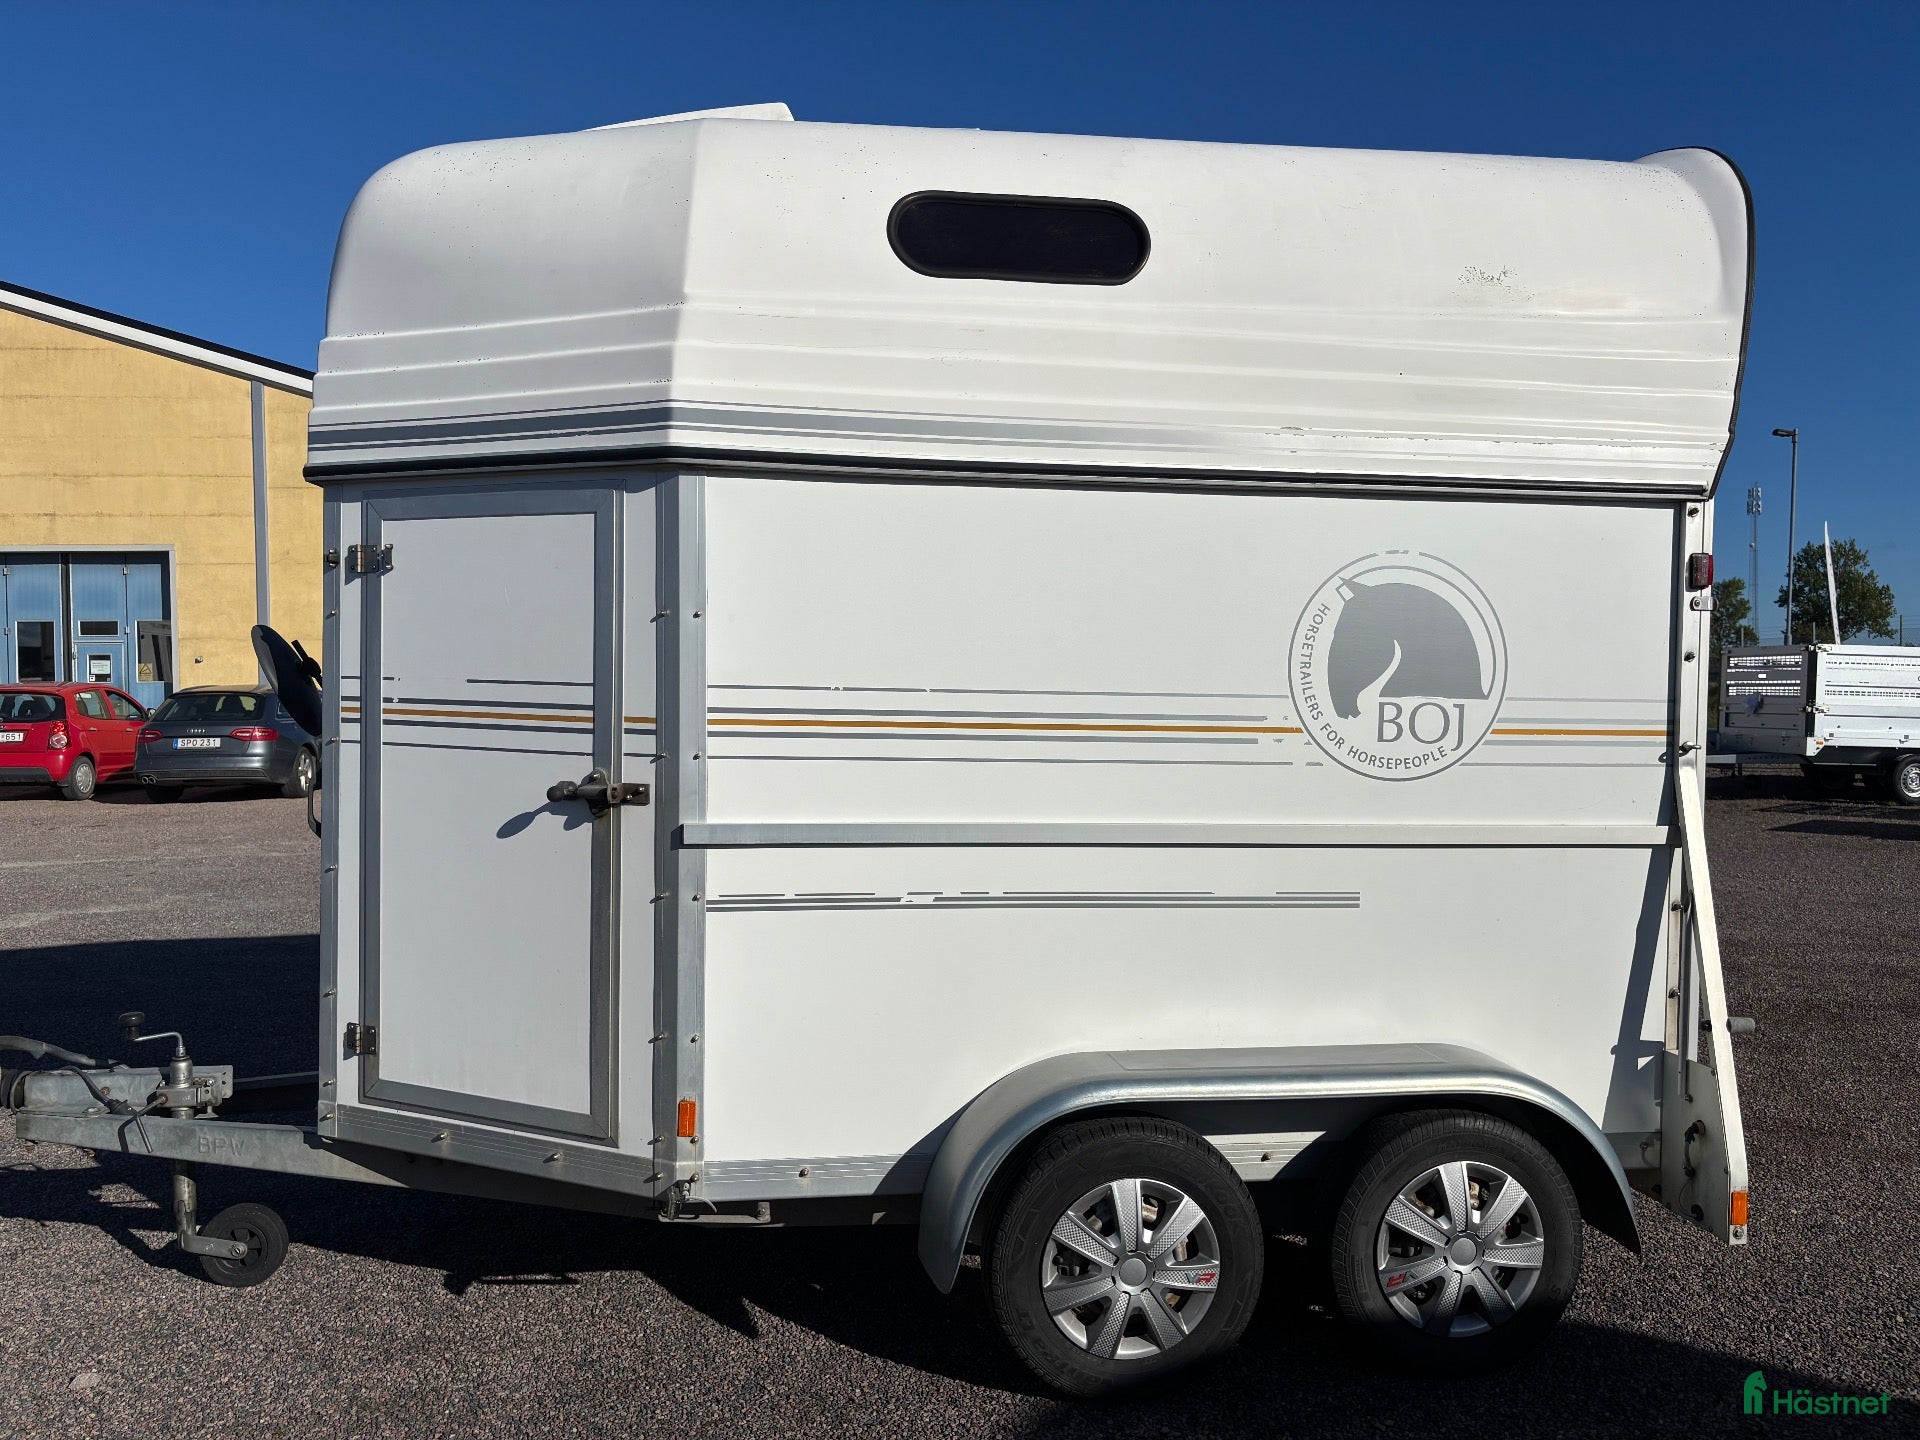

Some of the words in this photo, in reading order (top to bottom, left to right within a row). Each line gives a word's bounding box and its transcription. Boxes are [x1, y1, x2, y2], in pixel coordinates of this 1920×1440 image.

[1299, 603, 1331, 721] HORSETRAILERS
[1320, 722, 1344, 750] FOR
[1347, 745, 1448, 770] HORSEPEOPLE
[200, 739, 216, 747] 231
[1377, 701, 1466, 752] BOJ
[198, 1135, 245, 1157] BPW
